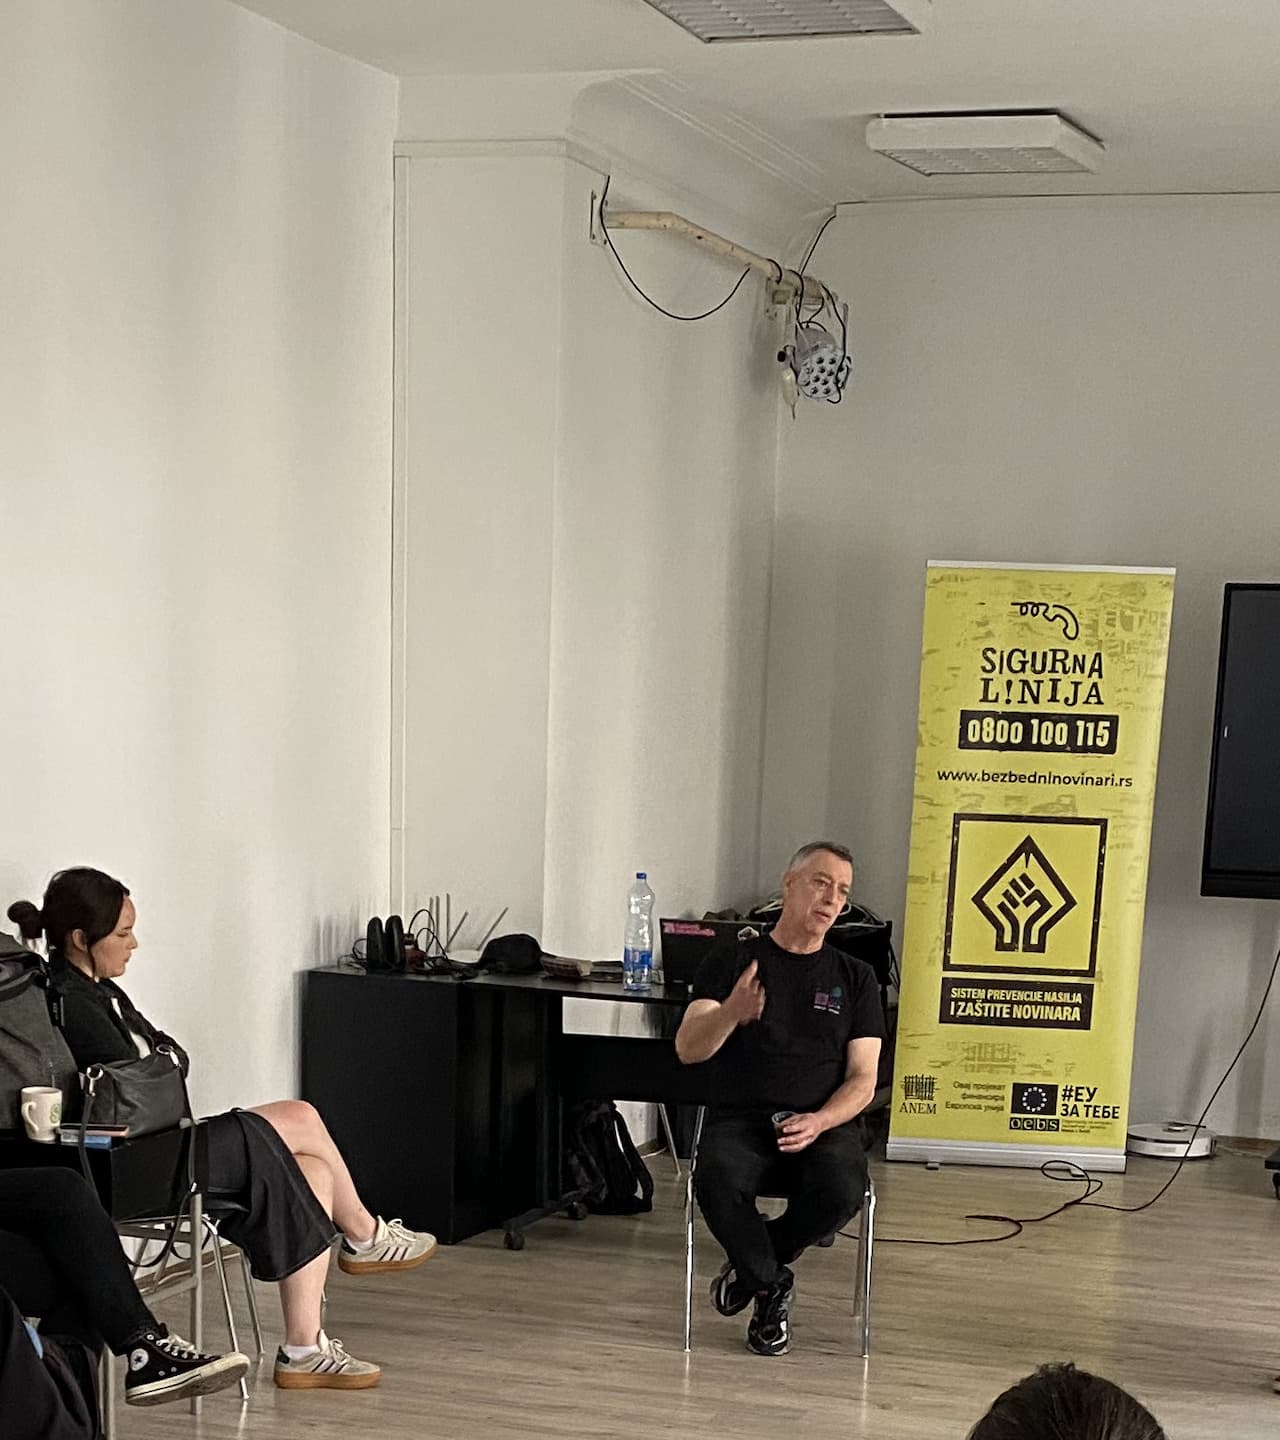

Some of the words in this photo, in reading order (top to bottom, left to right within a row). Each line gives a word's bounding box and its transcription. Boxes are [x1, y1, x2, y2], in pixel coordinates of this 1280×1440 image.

[980, 647, 1103, 679] SIGURNA
[979, 678, 1104, 706] L!NIJA
[967, 717, 1023, 744] 0800
[1030, 718, 1068, 746] 100
[1076, 720, 1110, 747] 115
[937, 769, 1133, 788] www.bezbedninovinari.rs
[951, 987, 985, 1000] SISTEM
[987, 990, 1043, 1002] PREVENCIJE
[1044, 991, 1082, 1004] NASILJA
[949, 1001, 955, 1015] I
[957, 1000, 1011, 1019] ZAŠTITE
[1013, 1004, 1081, 1022] NOVINARA
[898, 1101, 937, 1115] ANEM
[1060, 1104, 1080, 1118] ЗА
[1083, 1105, 1120, 1120] ТЕБЕ
